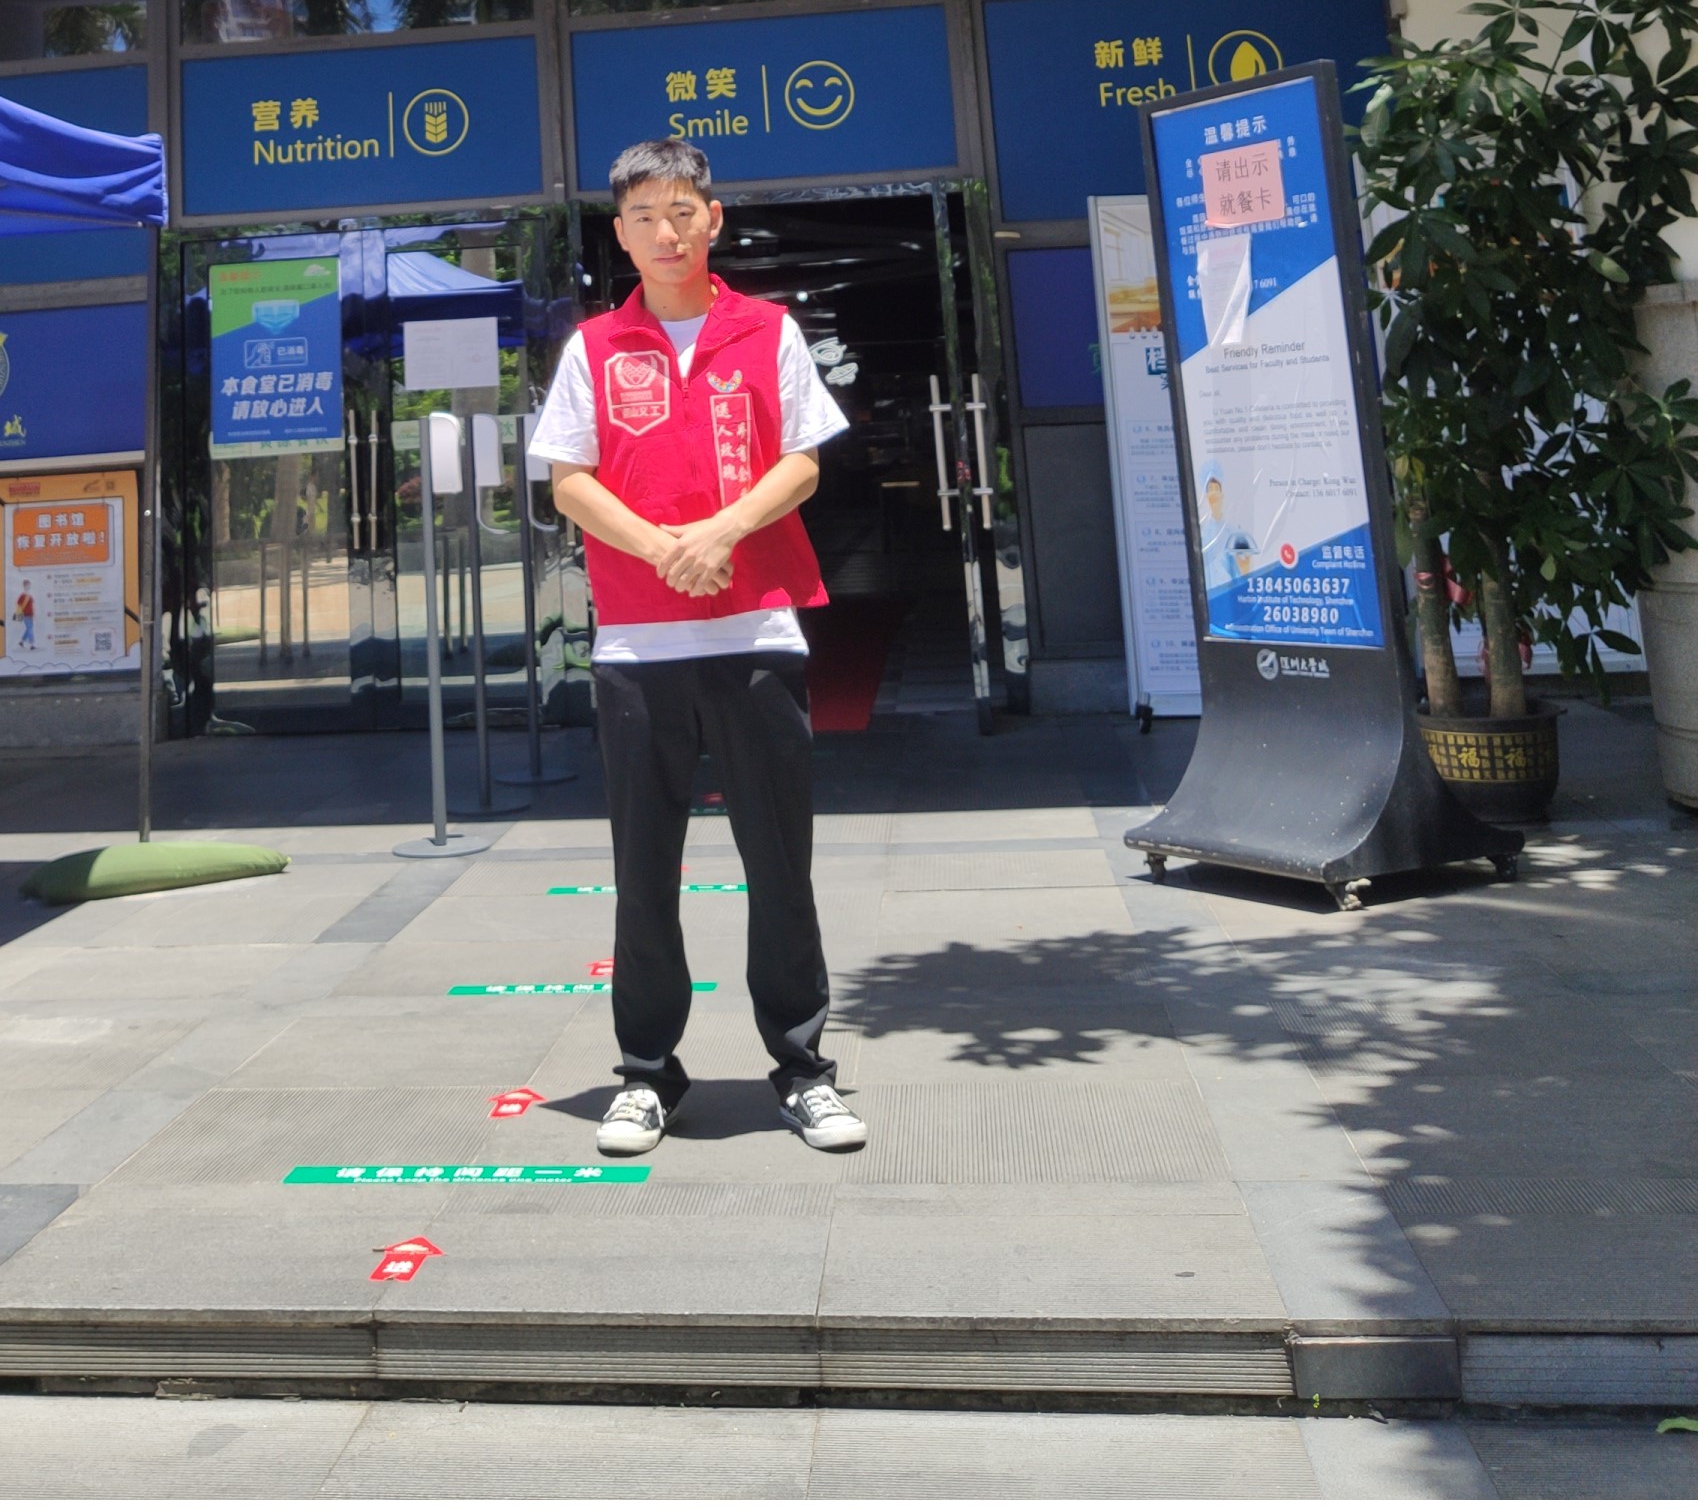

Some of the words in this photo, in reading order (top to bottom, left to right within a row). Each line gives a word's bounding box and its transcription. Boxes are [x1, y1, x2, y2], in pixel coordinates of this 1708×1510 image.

[1094, 35, 1164, 69] 新鲜
[665, 67, 736, 103] 微笑
[1099, 77, 1176, 108] Fresh
[251, 97, 320, 133] 营养
[669, 110, 748, 140] Smile
[1204, 115, 1267, 145] 温馨提示
[252, 133, 380, 168] Nutrition
[1216, 152, 1268, 182] 请出示
[1219, 187, 1272, 217] 就餐卡
[277, 345, 304, 356] 已消毒
[1224, 346, 1258, 359] Friendly
[1261, 341, 1306, 355] Reminder
[221, 372, 333, 396] 本食堂已消毒
[1322, 546, 1365, 559] 监督电话
[1247, 577, 1350, 594] 13845063637
[1263, 606, 1339, 623] 26038980
